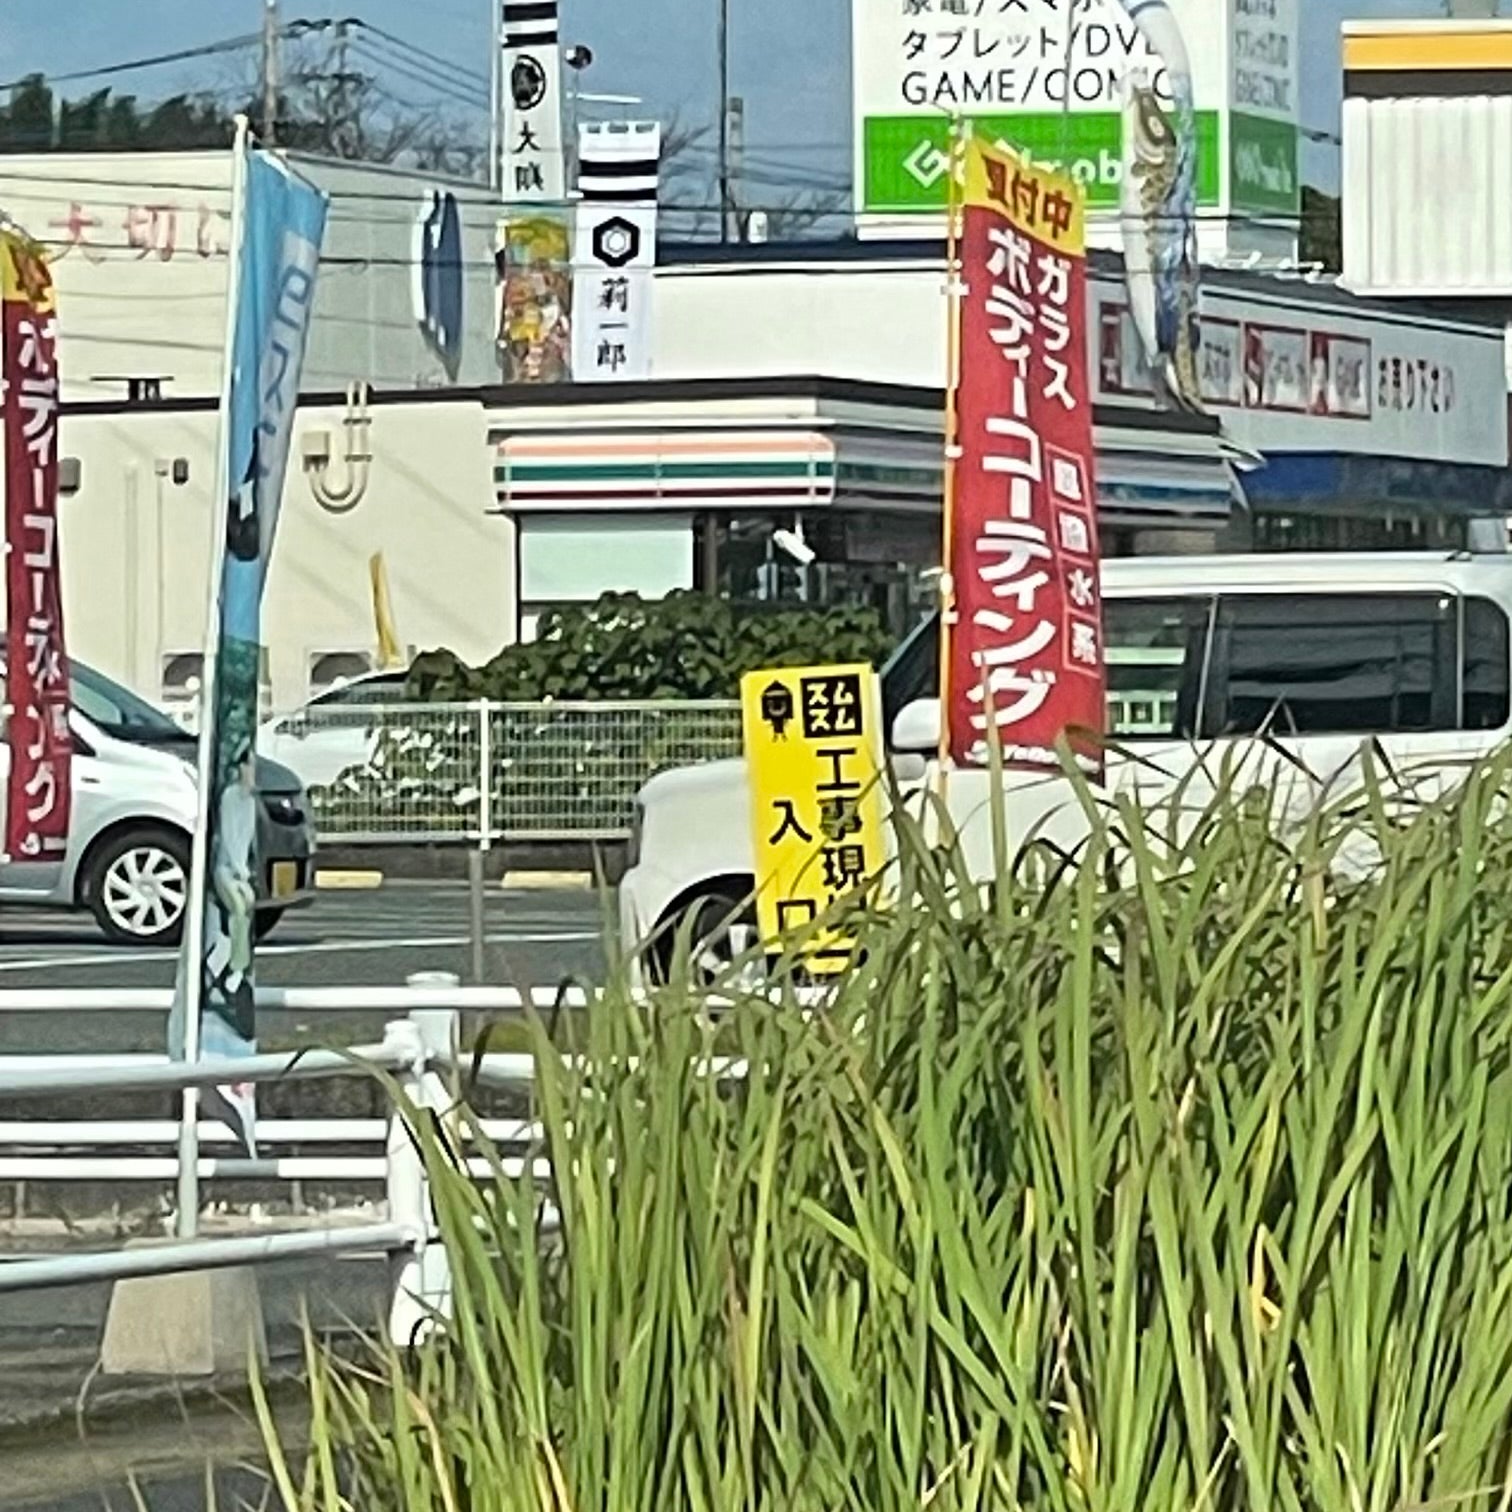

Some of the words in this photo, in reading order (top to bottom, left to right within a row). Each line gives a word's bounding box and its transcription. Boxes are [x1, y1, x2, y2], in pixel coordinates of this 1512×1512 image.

[902, 67, 1175, 104] GAME/COC
[1037, 254, 1076, 410] ガラス
[966, 228, 1055, 729] ボディーコーティング
